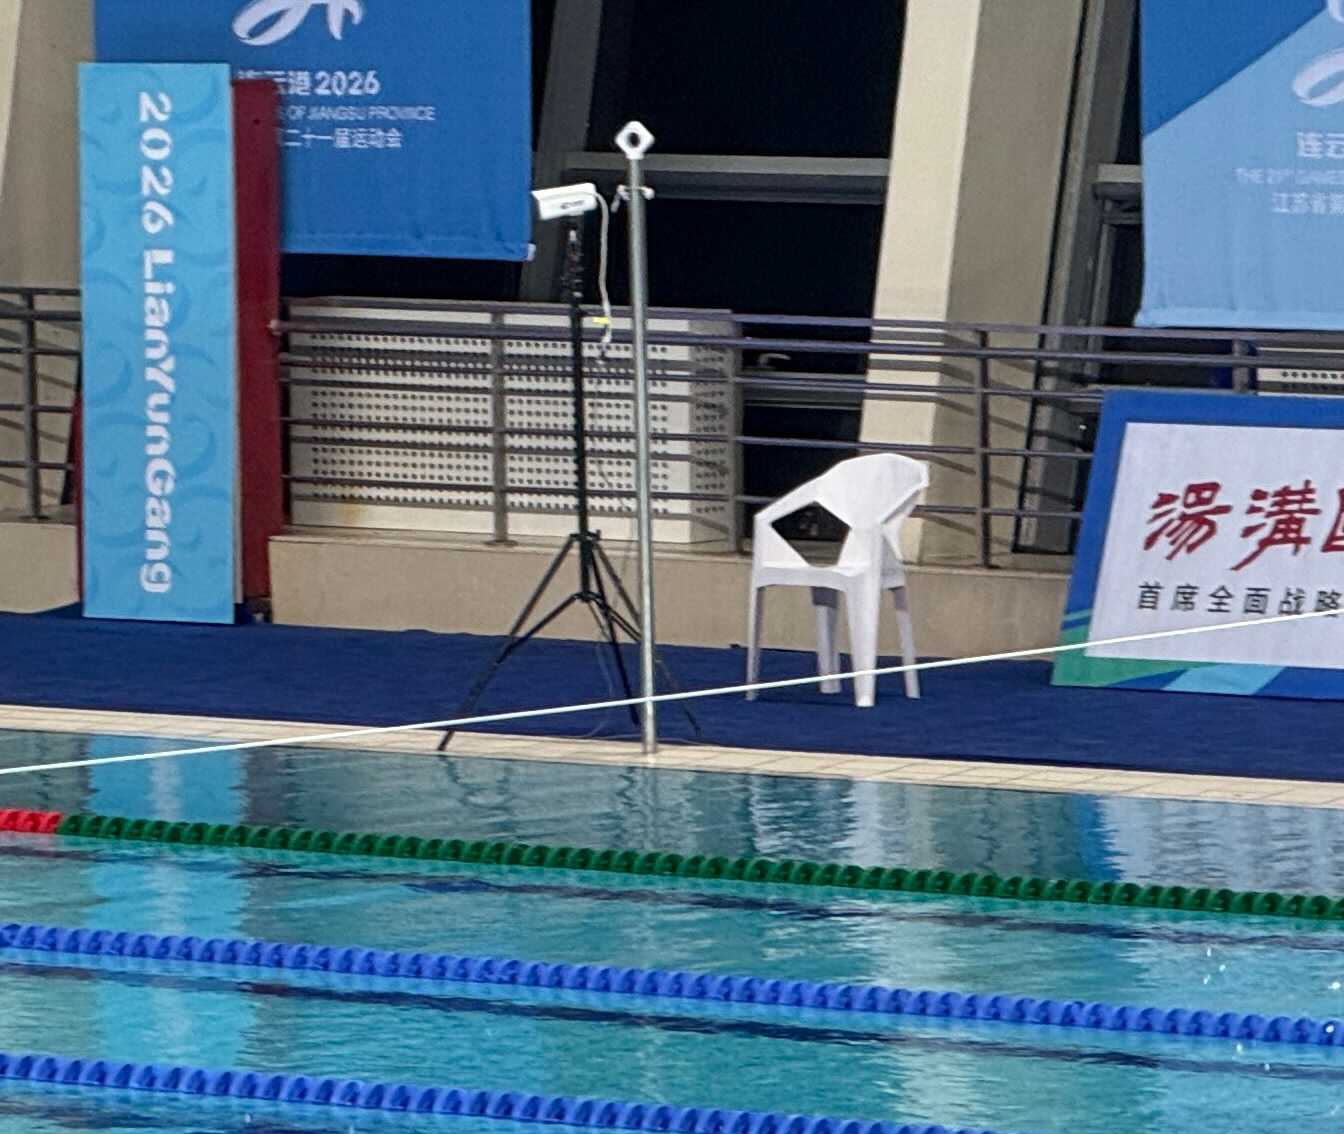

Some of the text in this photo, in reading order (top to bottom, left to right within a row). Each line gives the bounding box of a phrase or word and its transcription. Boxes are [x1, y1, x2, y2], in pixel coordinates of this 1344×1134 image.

[314, 70, 381, 96] 2026
[140, 92, 176, 593] 2026 LianYunGang
